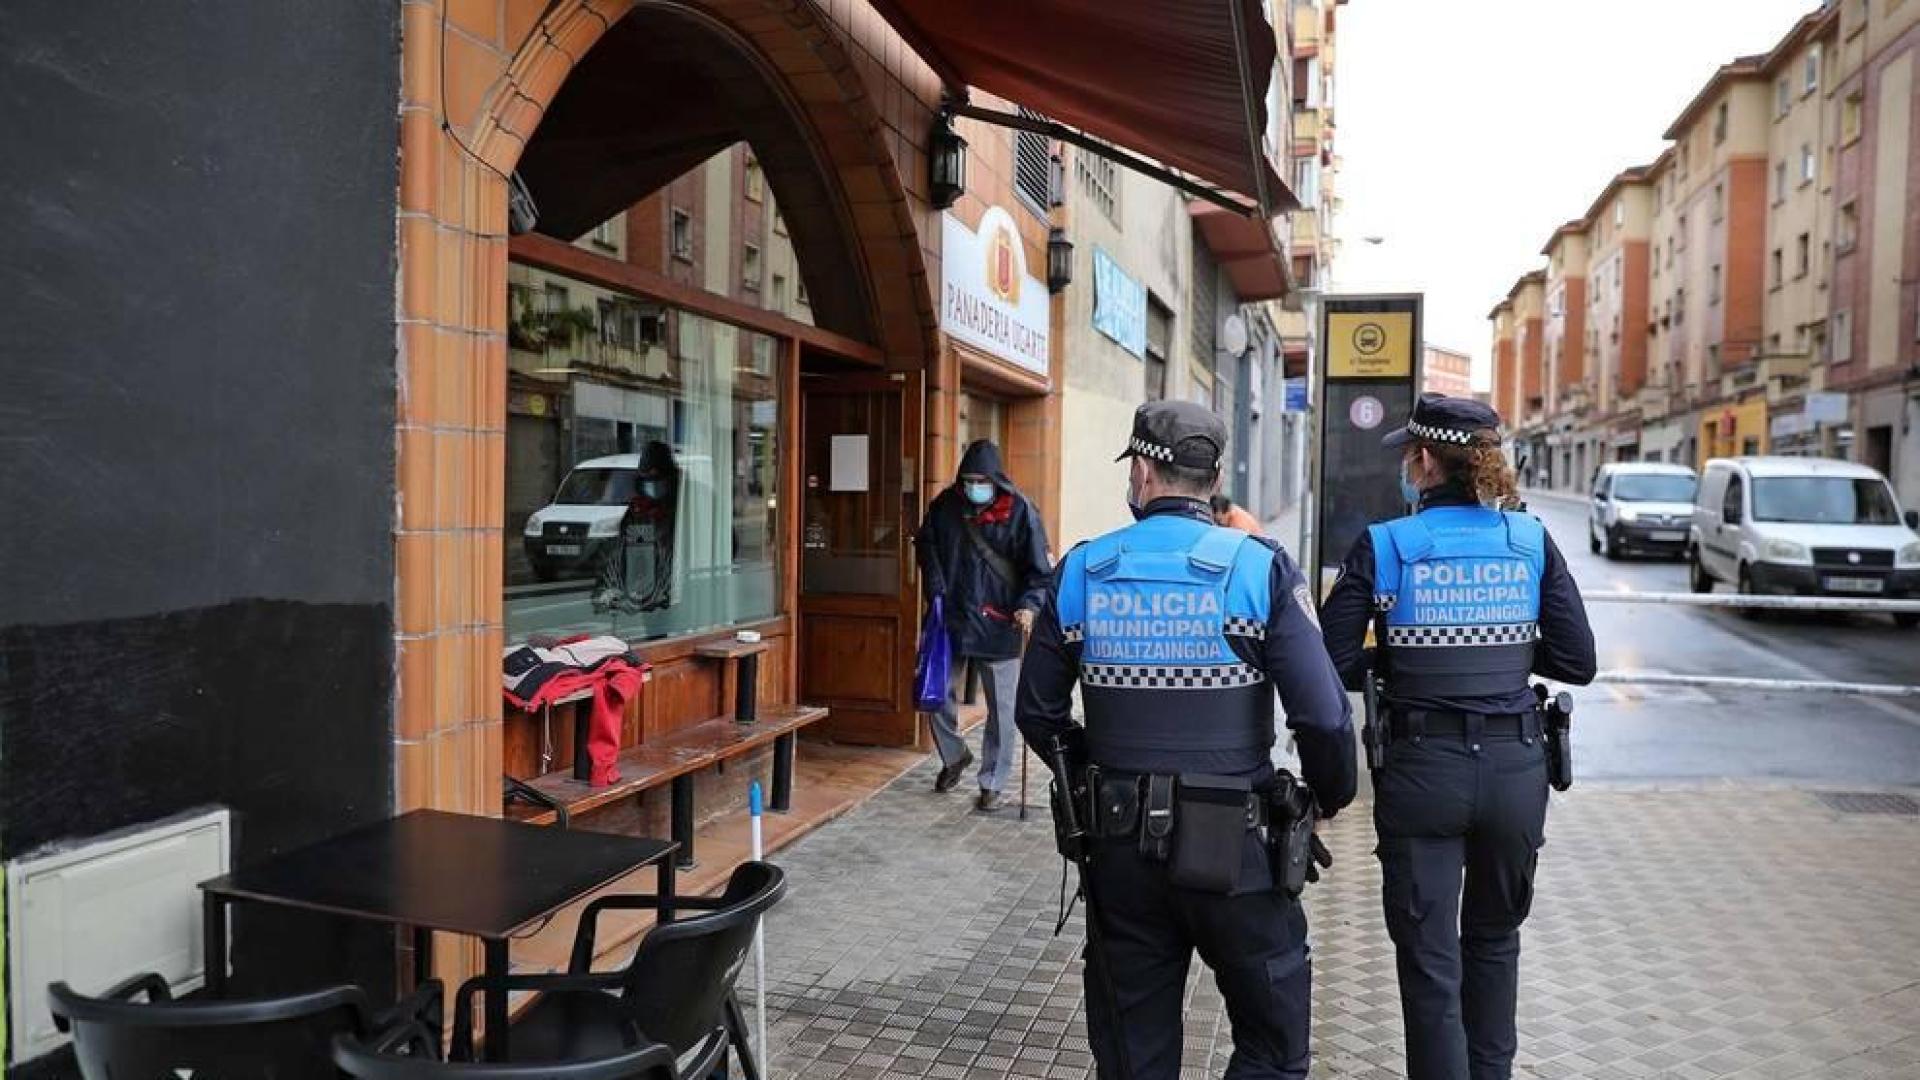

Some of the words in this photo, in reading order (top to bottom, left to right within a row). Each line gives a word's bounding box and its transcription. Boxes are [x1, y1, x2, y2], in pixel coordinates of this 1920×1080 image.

[1415, 560, 1530, 585] POLICIA
[1090, 592, 1219, 616] POLICIA
[1415, 586, 1530, 604] MUNICIPAL
[1415, 605, 1530, 624] UDALTZAINGOA
[1090, 619, 1217, 637] MUNICIPAL
[1091, 639, 1222, 659] UDALTZAINGOA
